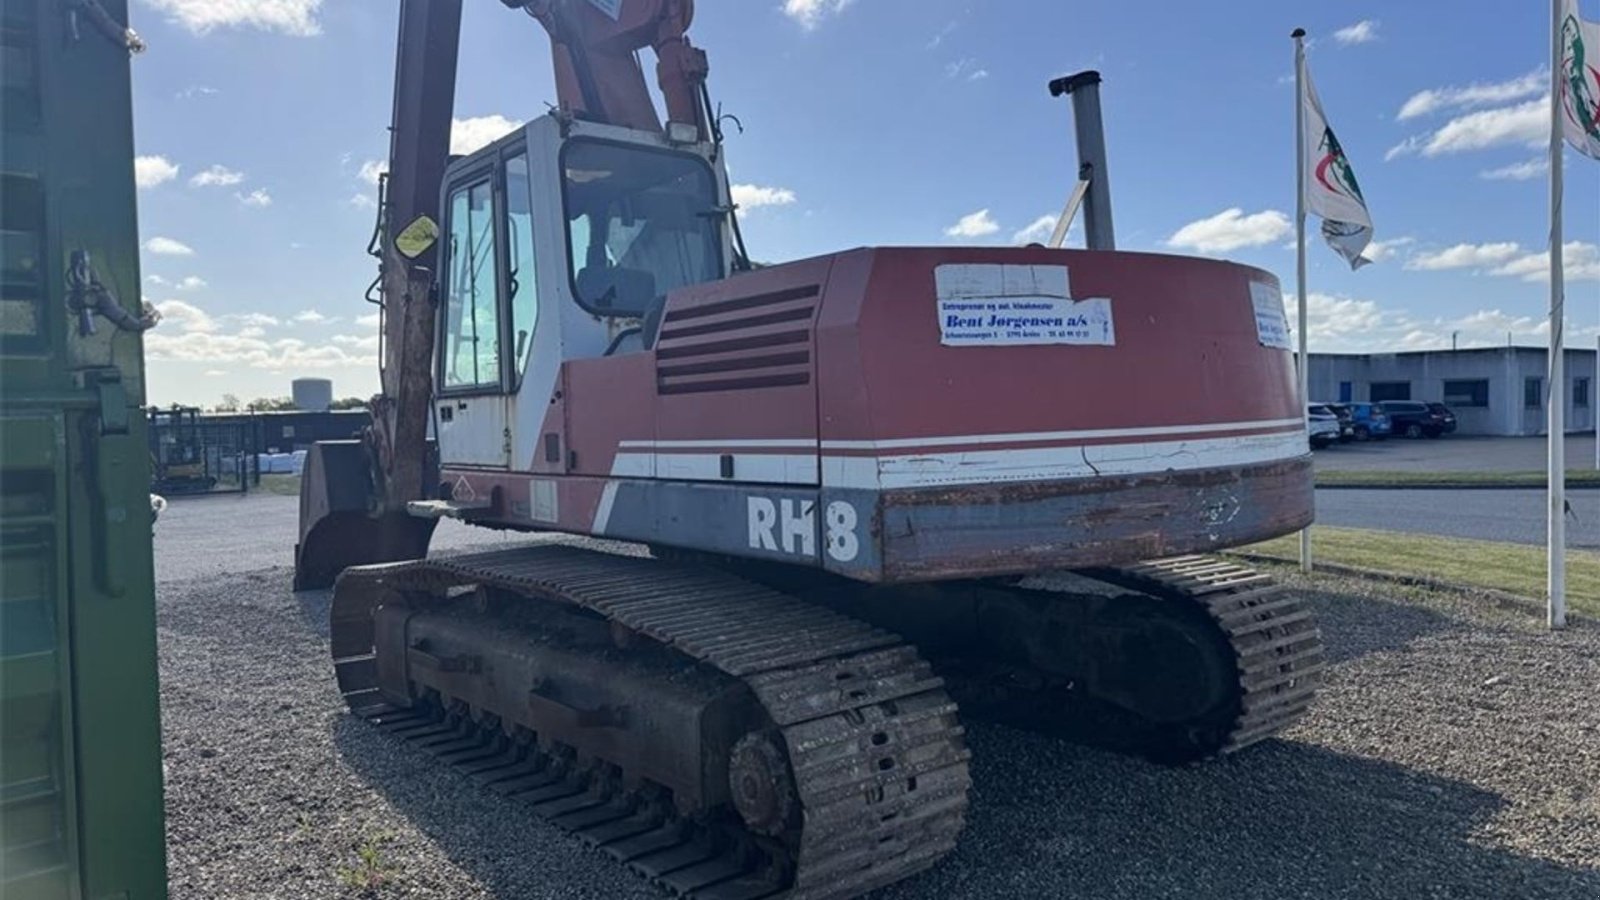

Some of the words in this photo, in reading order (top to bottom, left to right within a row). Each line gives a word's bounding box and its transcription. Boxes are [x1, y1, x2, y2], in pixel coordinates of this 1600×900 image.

[947, 315, 983, 328] Bent
[987, 315, 1063, 330] Jørgensen
[1067, 314, 1088, 327] a/s
